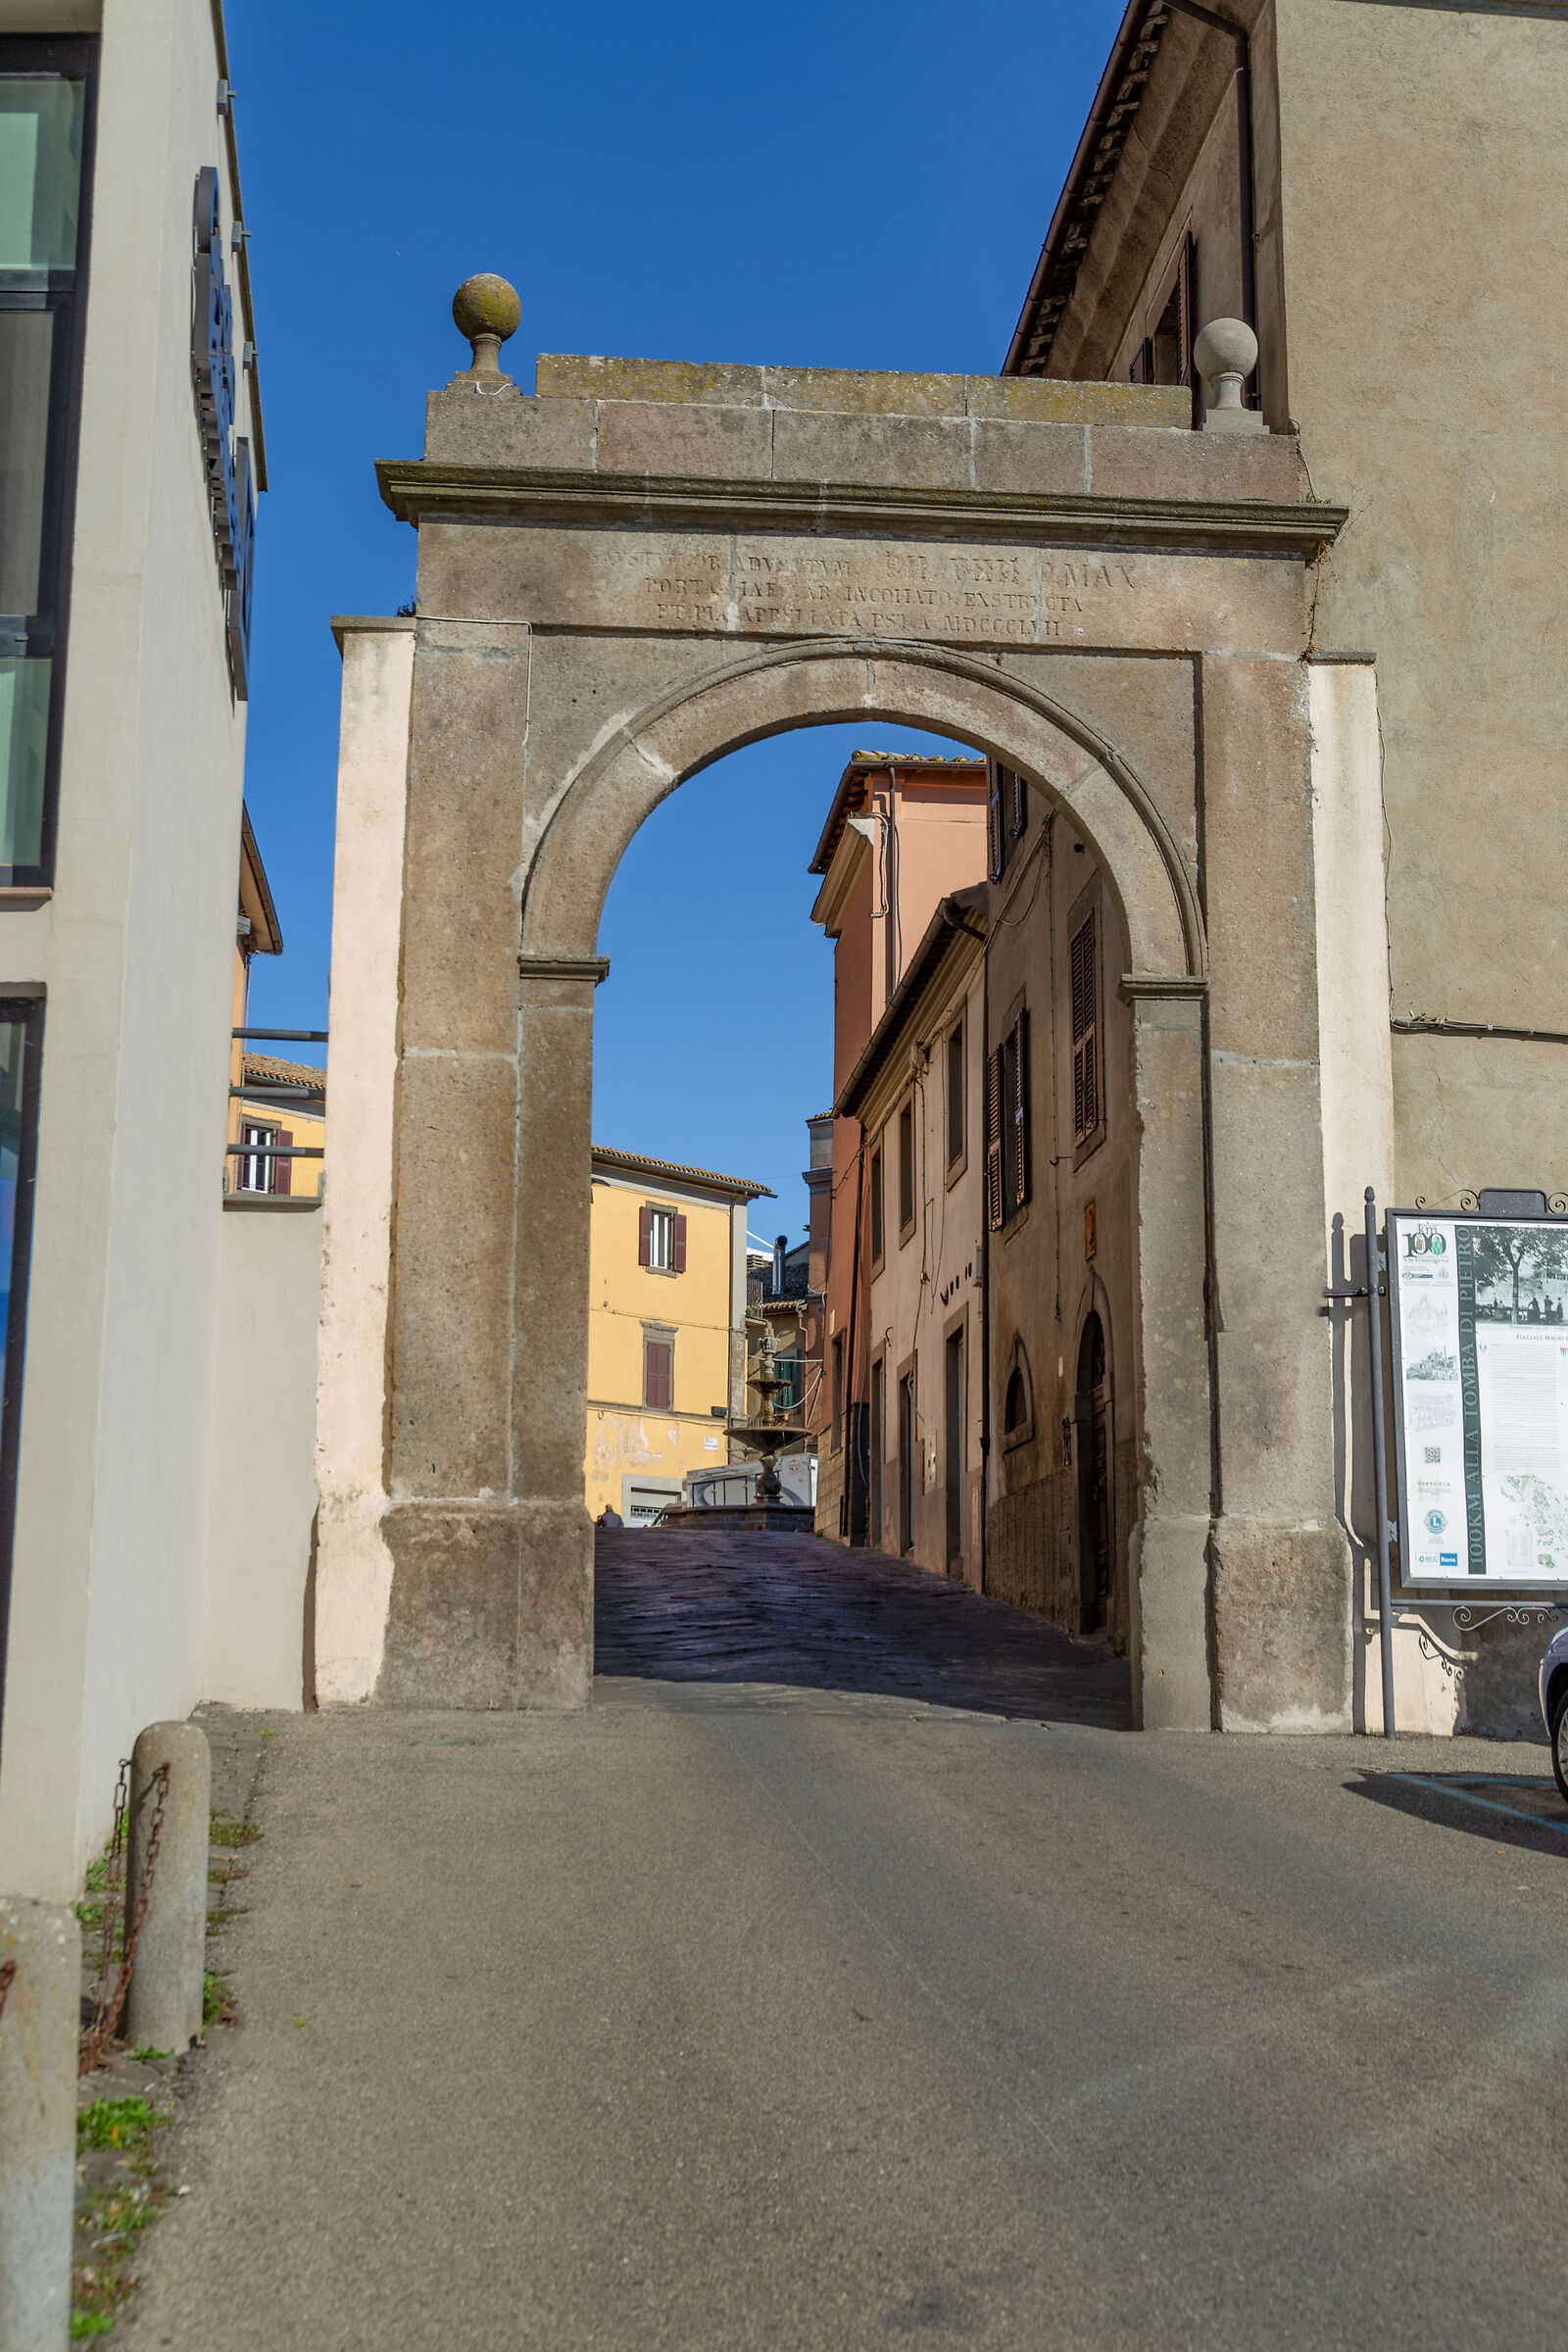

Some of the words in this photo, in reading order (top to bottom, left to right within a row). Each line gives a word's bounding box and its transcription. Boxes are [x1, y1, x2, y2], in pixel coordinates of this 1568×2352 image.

[658, 604, 685, 619] ET
[1401, 1233, 1446, 1260] 100
[1456, 1226, 1473, 1300] PIETRO
[1460, 1310, 1474, 1334] DI
[1461, 1343, 1478, 1419] TOMBA
[1465, 1429, 1481, 1485] ALLA
[1468, 1494, 1485, 1565] 100KM
